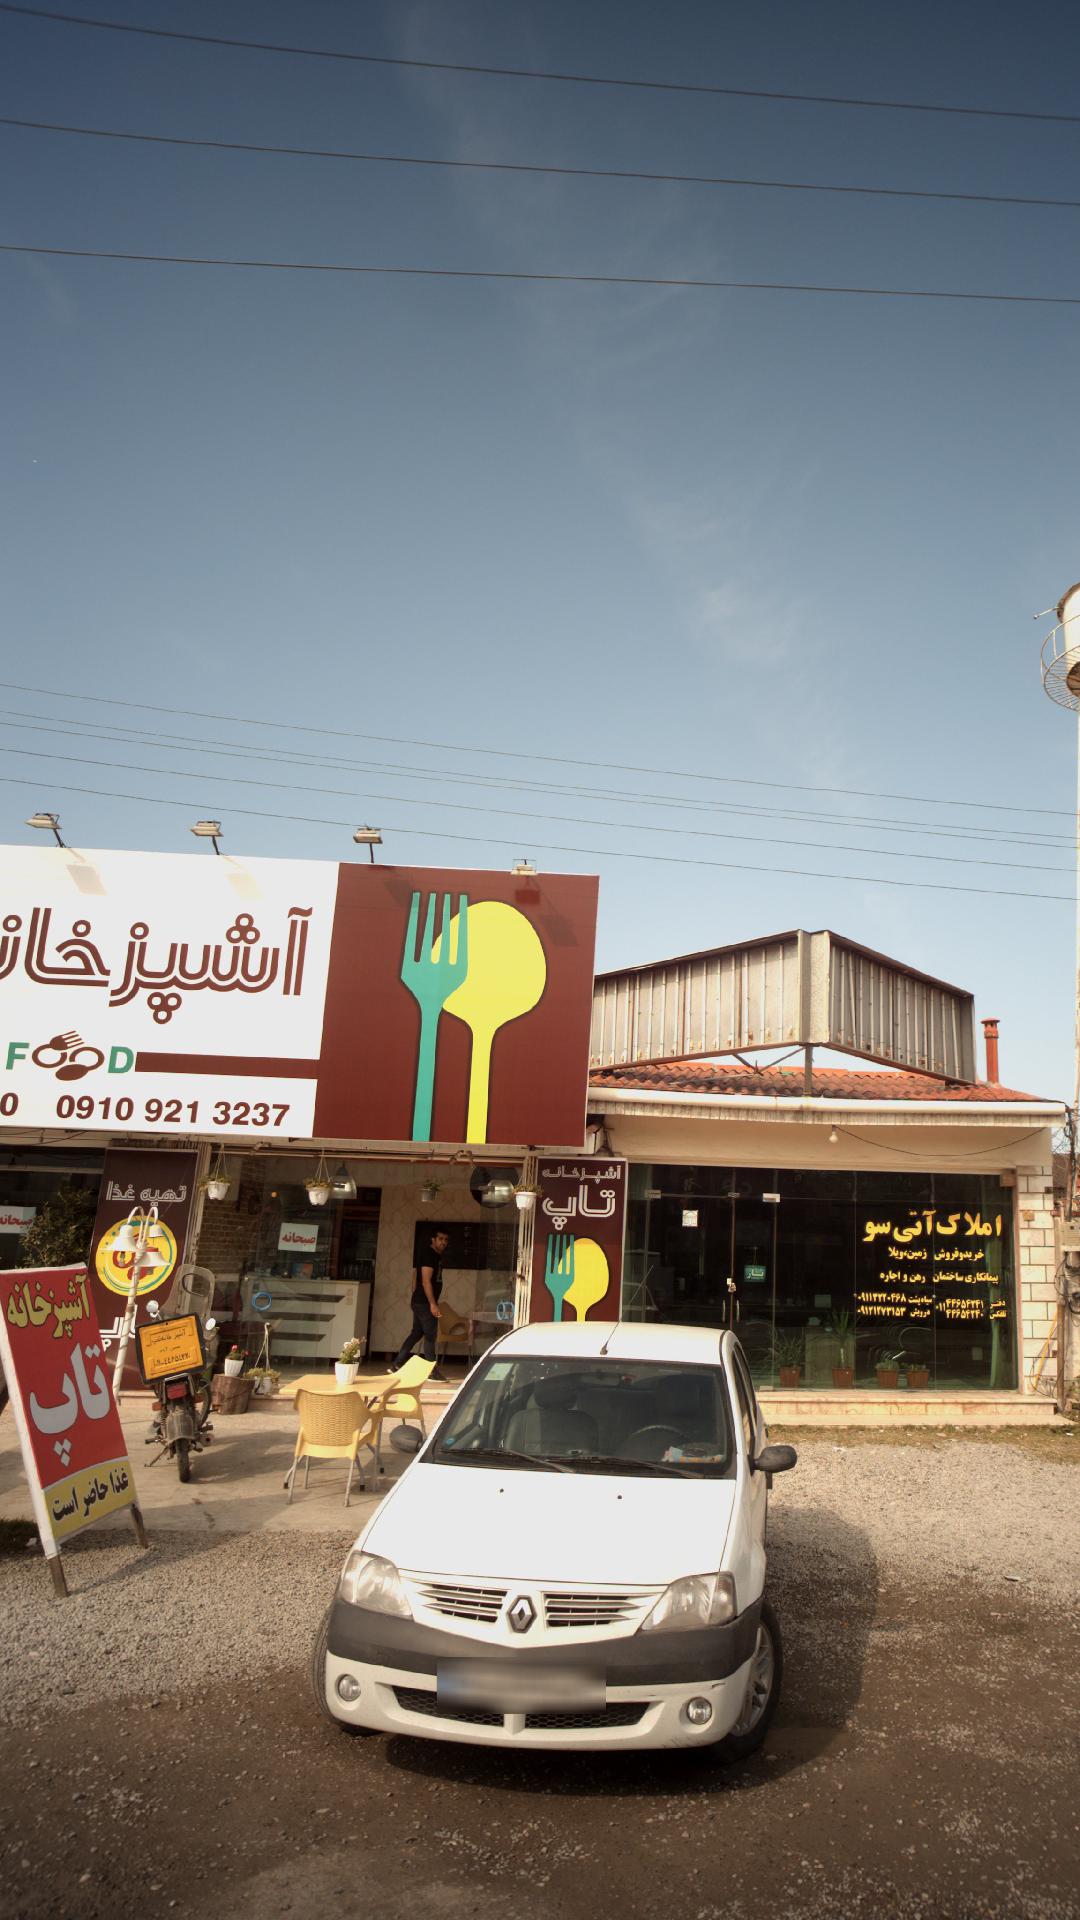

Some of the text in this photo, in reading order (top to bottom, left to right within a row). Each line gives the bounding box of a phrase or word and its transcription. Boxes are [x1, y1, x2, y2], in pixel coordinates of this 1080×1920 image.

[0, 906, 313, 1025] آشپزخان
[56, 1094, 134, 1121] 0910
[144, 1097, 199, 1124] 921
[213, 1101, 290, 1127] 3237
[106, 1180, 187, 1207] تهیه غذا
[542, 1184, 616, 1231] تاپ
[281, 1231, 316, 1246] صبحانه
[863, 1219, 891, 1242] سو
[936, 1211, 1003, 1237] املاک
[880, 1269, 901, 1282] اجاره
[7, 1274, 90, 1338] آشپزخانه
[29, 1342, 110, 1467] تاپ
[52, 1468, 129, 1521] غذا حاضر است
